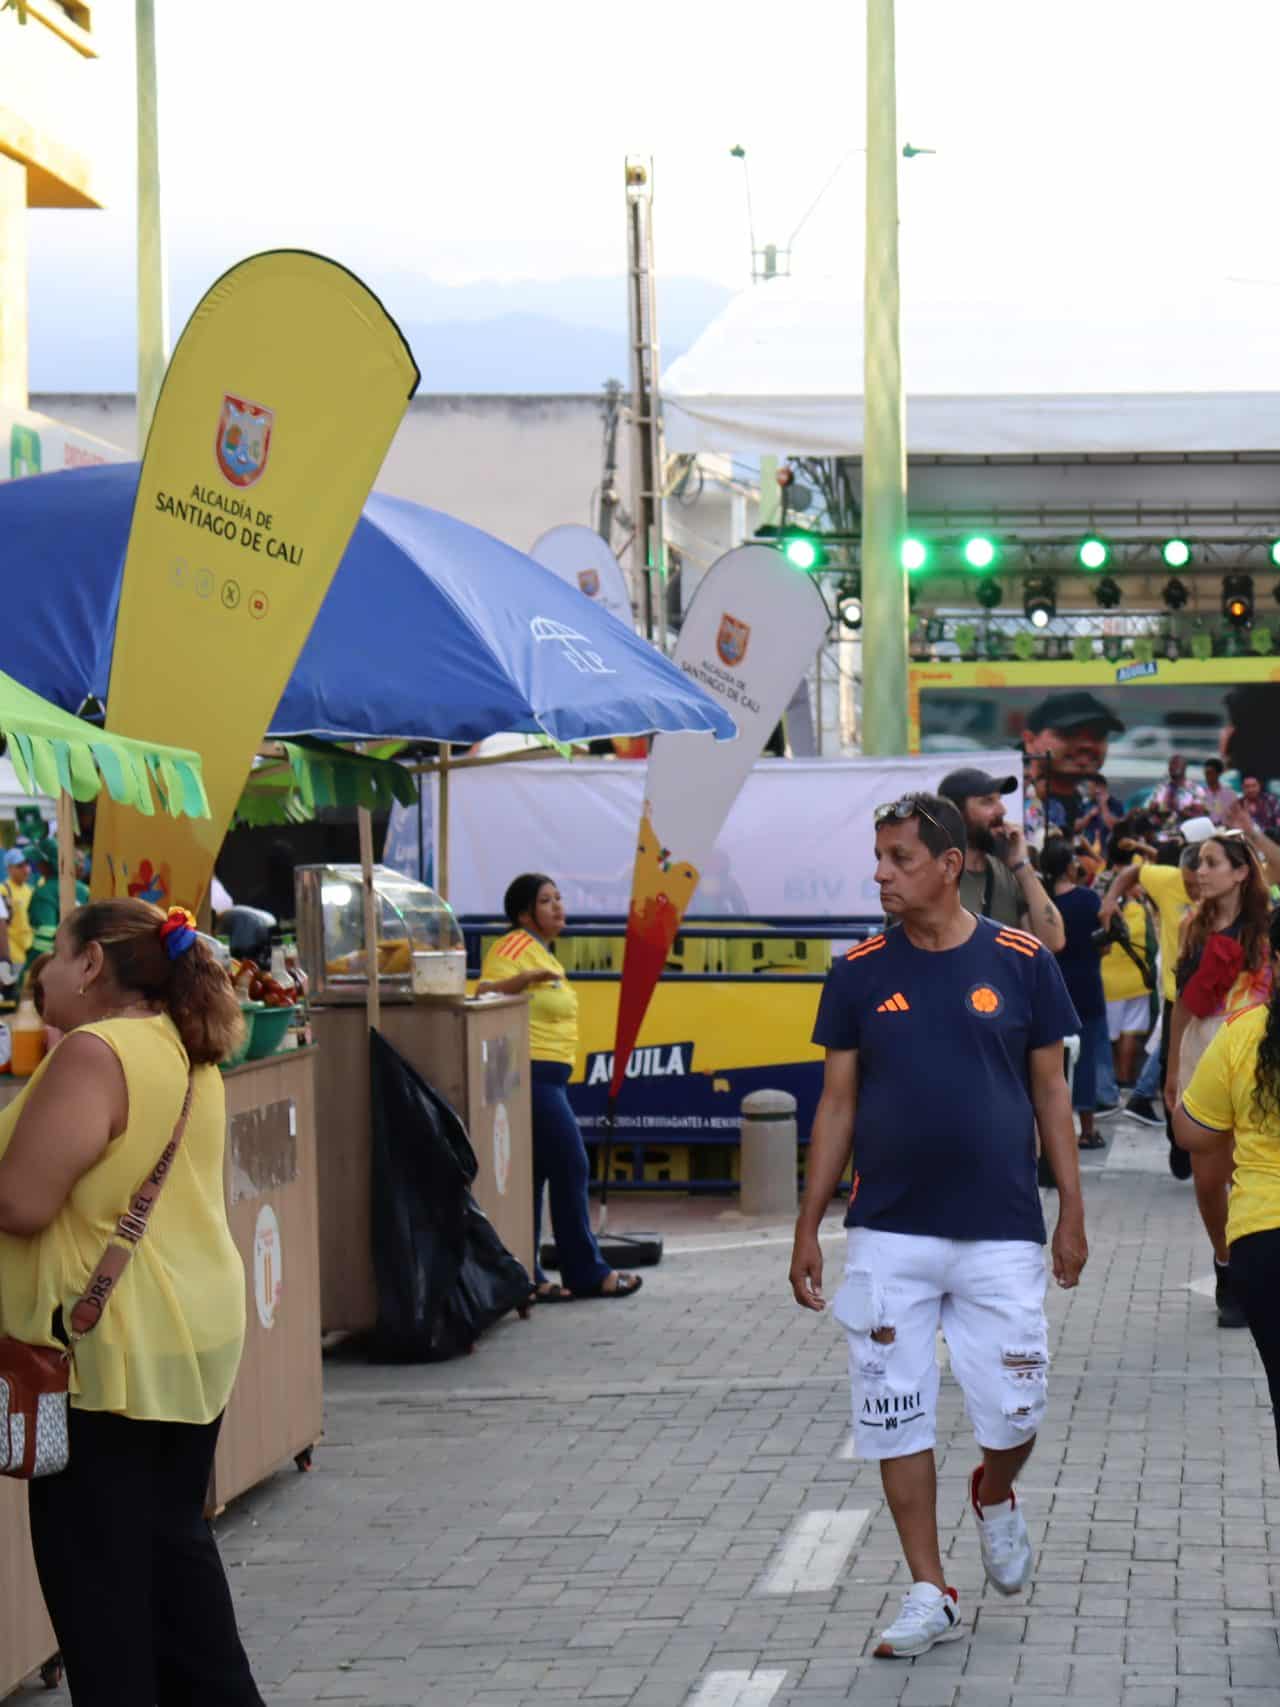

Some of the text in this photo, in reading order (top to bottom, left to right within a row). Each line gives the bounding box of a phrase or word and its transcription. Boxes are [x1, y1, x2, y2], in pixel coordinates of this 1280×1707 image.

[156, 491, 304, 566] SANTIAGO DE CALI
[256, 511, 273, 530] DE
[588, 1045, 686, 1086] AUILA
[863, 1391, 921, 1415] AMIRI
